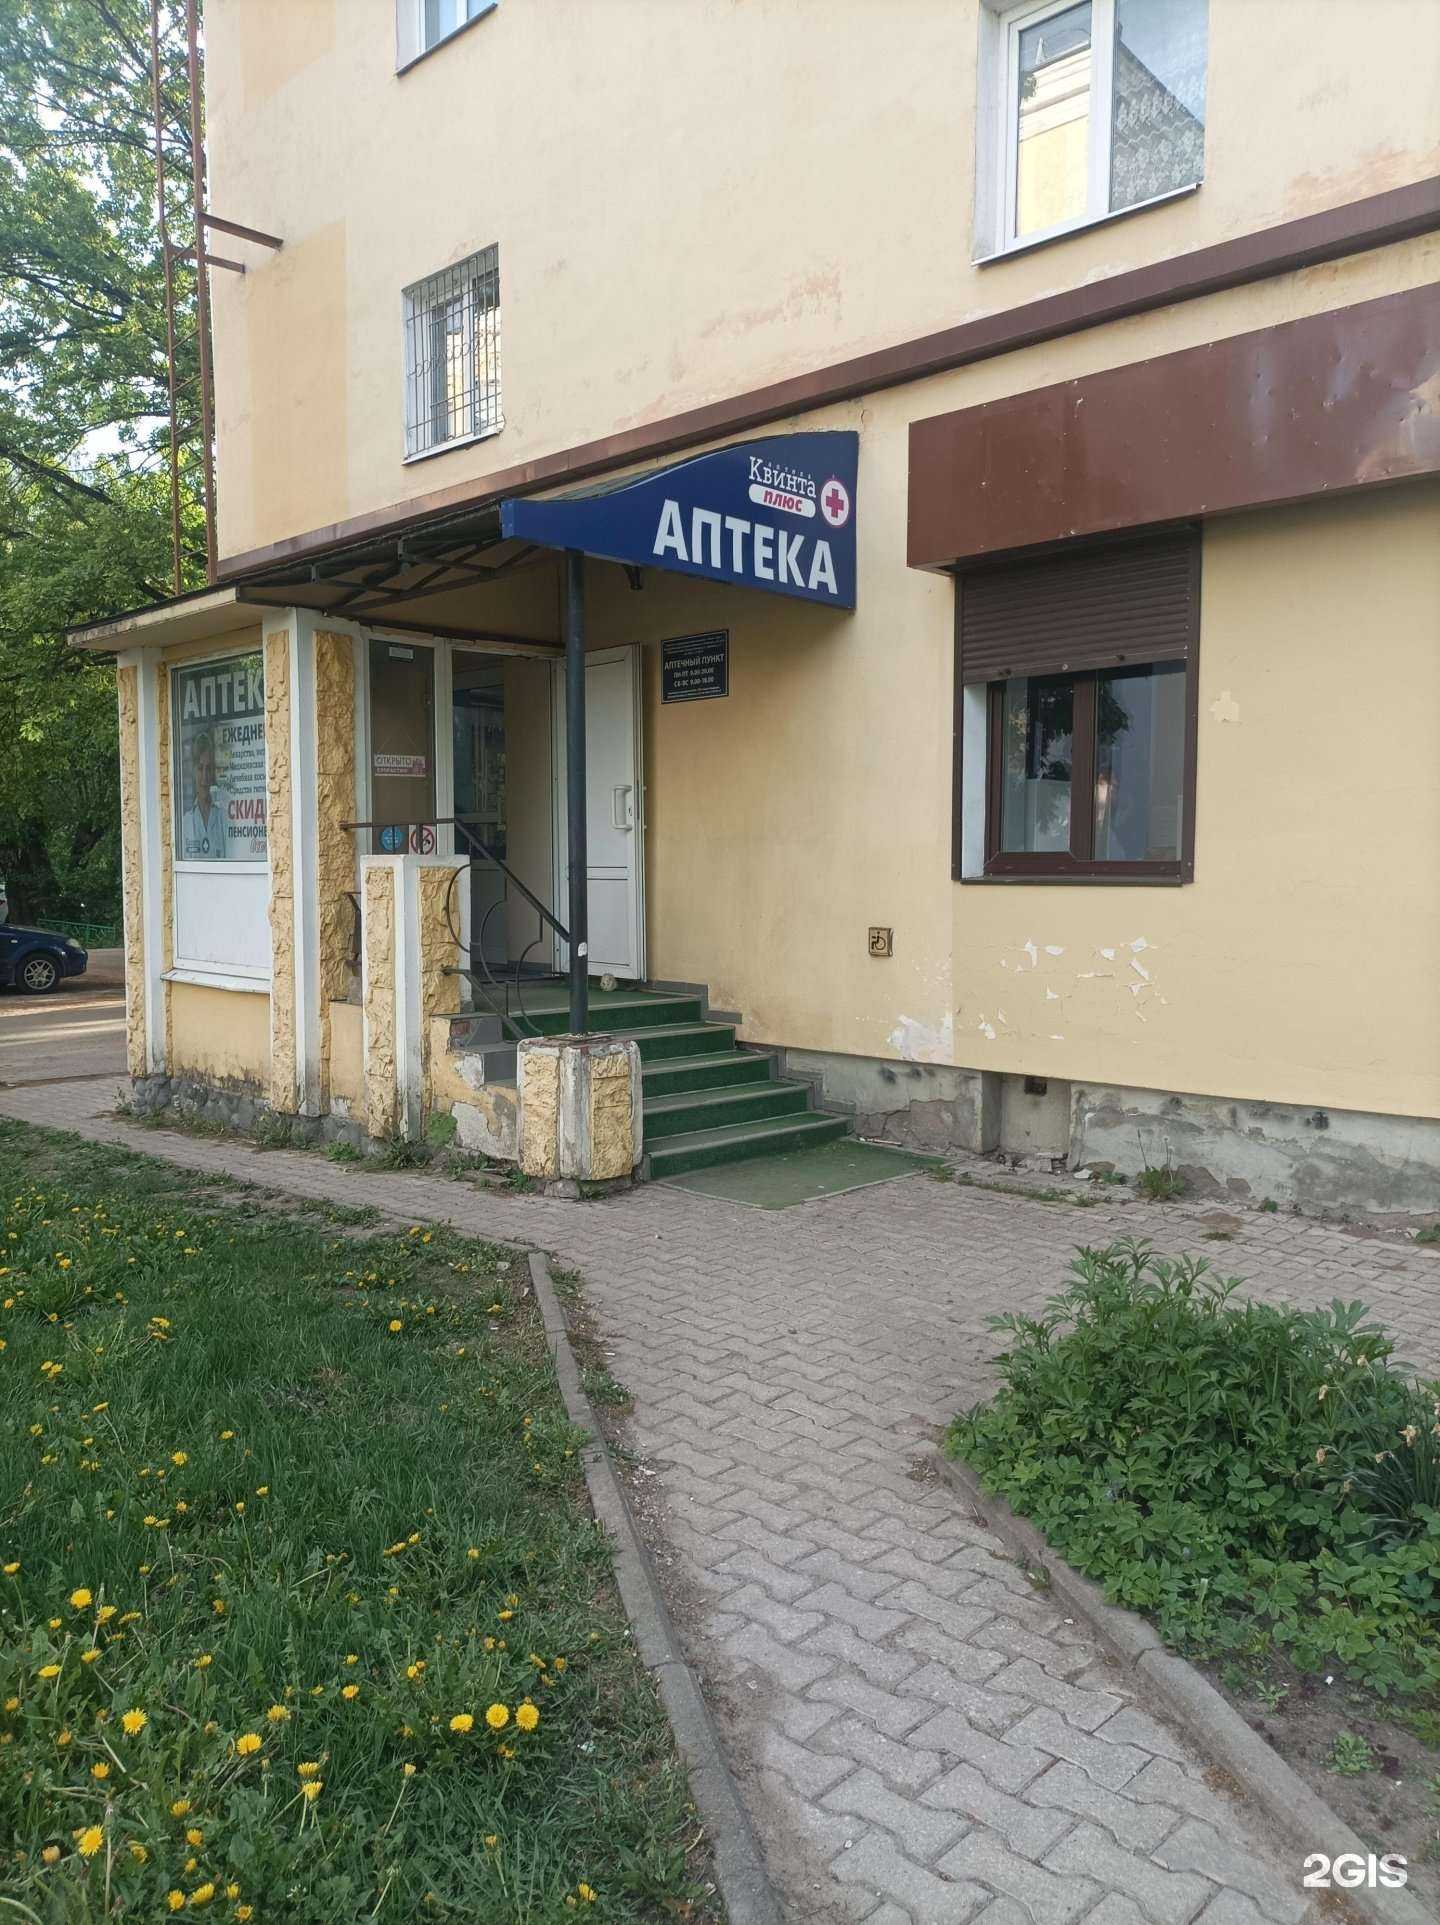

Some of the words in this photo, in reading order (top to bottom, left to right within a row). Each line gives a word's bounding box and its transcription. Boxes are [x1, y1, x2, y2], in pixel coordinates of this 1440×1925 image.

[749, 456, 816, 498] Квинта
[653, 499, 838, 594] АПТЕКА
[664, 656, 701, 670] АПТЕЧНЫЙ
[702, 653, 724, 665] ПУНКТ
[223, 723, 265, 746] ЕЖЕДНЕ
[228, 799, 267, 824] СКИД
